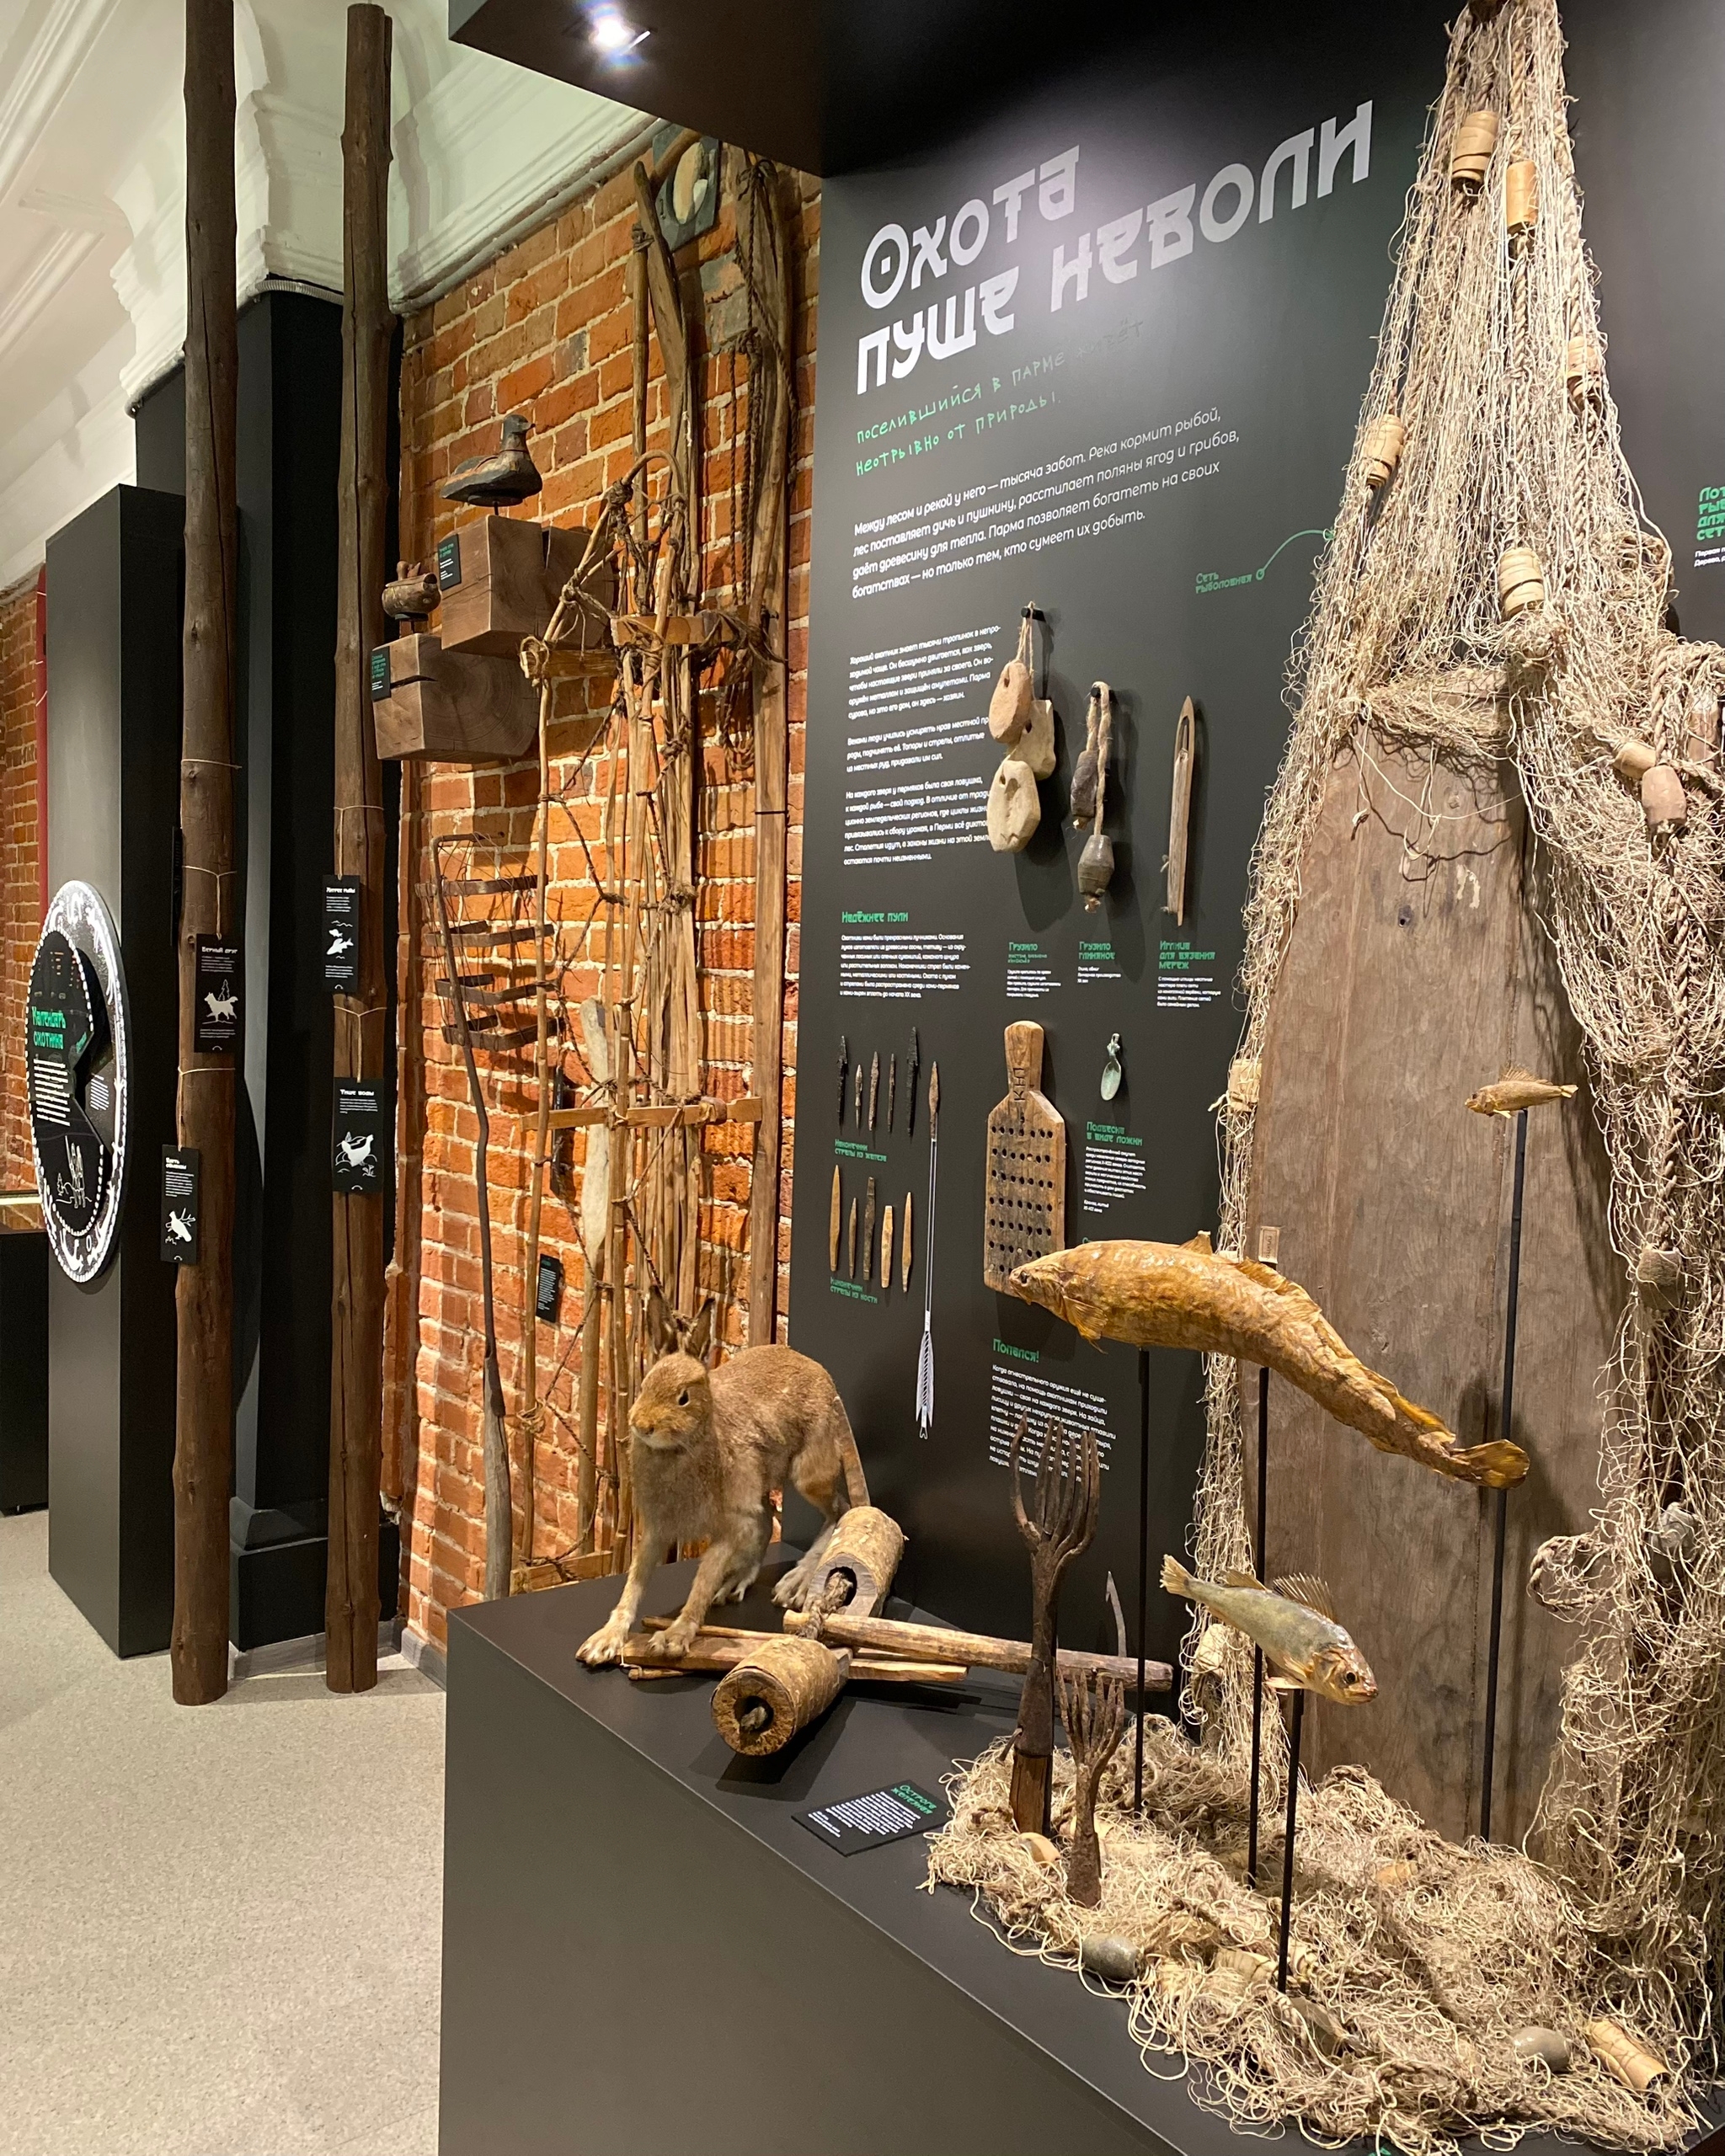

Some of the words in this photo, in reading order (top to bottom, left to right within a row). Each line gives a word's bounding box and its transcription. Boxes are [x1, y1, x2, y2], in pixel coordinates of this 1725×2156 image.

[1050, 99, 1373, 312] неволи
[861, 145, 1080, 309] Охота
[853, 517, 885, 536] Между
[885, 507, 915, 526] лесом
[915, 504, 922, 516] и
[923, 493, 953, 516] рекой
[953, 492, 961, 507] у
[962, 484, 986, 501] него
[999, 466, 1043, 488] тысяча
[1044, 453, 1093, 474] забот.
[1088, 442, 1117, 460] Река
[1120, 424, 1172, 450] кормит
[1174, 407, 1220, 435] рыбой,
[852, 543, 869, 557] лес
[869, 525, 931, 551] поставляет
[932, 517, 956, 536] дичь
[957, 514, 964, 525] и
[965, 499, 1016, 523] пушнину,
[1017, 474, 1094, 507] расстилает
[1096, 459, 1142, 482] поляны
[1145, 449, 1174, 467] ягод
[1177, 446, 1186, 457] и
[1188, 430, 1239, 455] грибов,
[852, 561, 879, 580] даёт
[879, 547, 928, 573] древесину
[929, 541, 948, 558] для
[949, 530, 986, 549] тепла.
[988, 518, 1024, 538] Парма
[1026, 499, 1090, 526] позволяет
[1092, 481, 1159, 507] богатеть
[1162, 473, 1178, 488] на
[1181, 461, 1220, 482] своих
[852, 574, 910, 598] богатствах
[921, 567, 934, 579] но
[935, 556, 974, 575] только
[975, 548, 1001, 564] тем,
[1003, 541, 1027, 557] кто
[1028, 528, 1074, 551] сумеет
[1076, 523, 1090, 536] их
[1092, 510, 1145, 535] добыть.
[841, 911, 884, 923] Надёжнее
[888, 912, 908, 922] пули
[1008, 942, 1038, 952] Грузило
[1078, 952, 1116, 960] глиняное
[1079, 942, 1111, 951] Грузило
[1159, 952, 1176, 960] для
[1179, 952, 1215, 960] вязания
[1159, 961, 1189, 969] мереж
[993, 1338, 1039, 1363] Попался!
